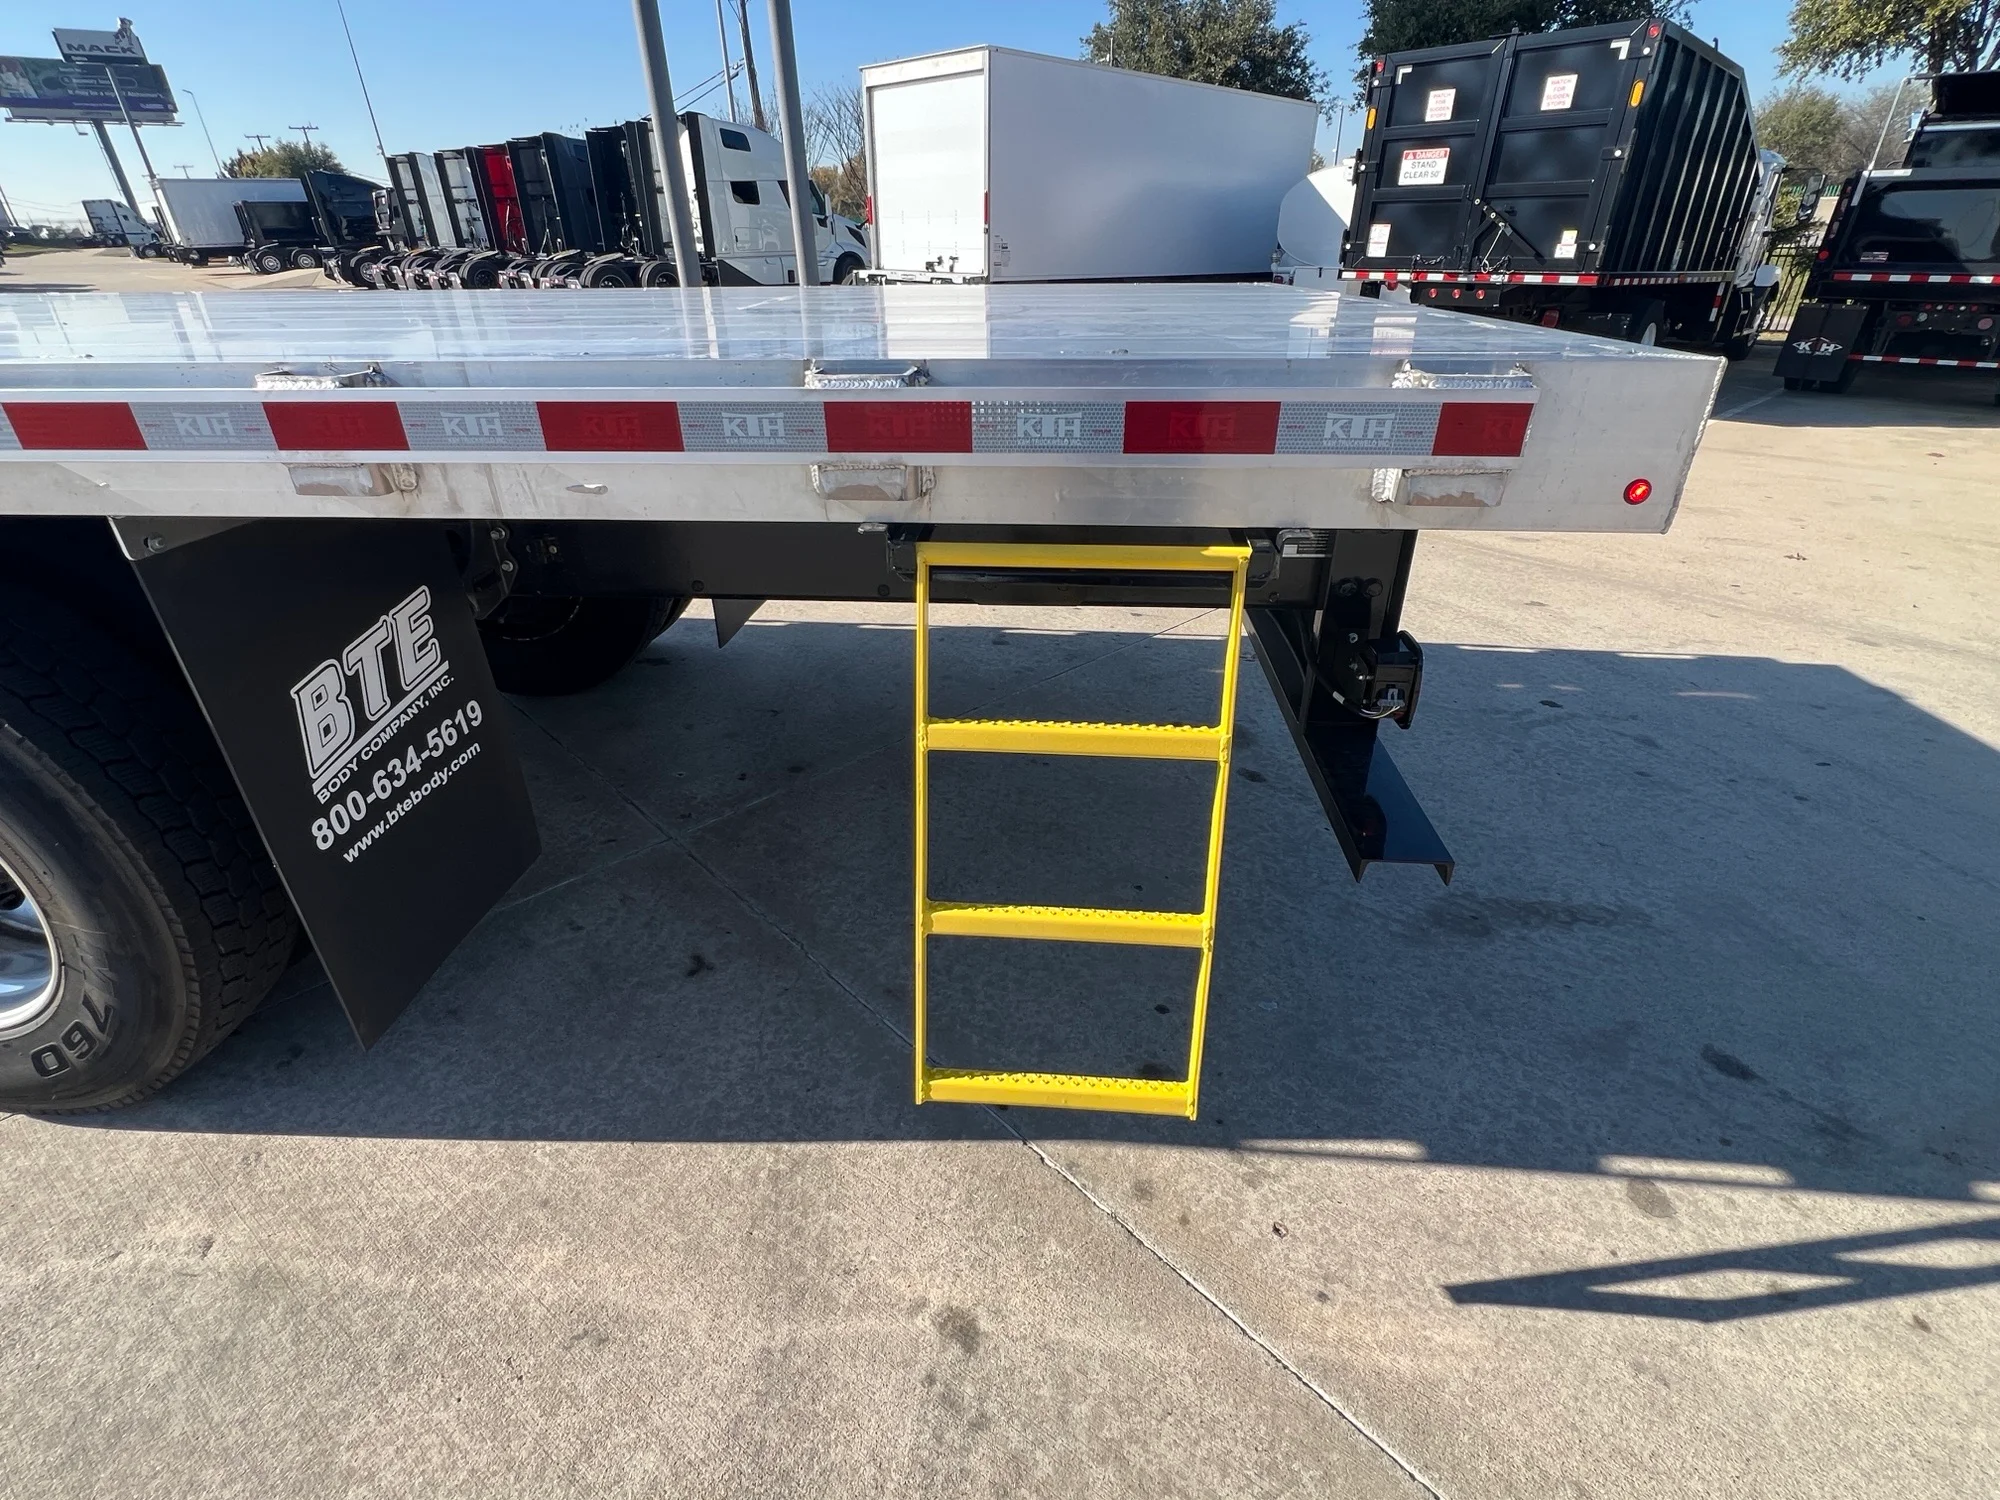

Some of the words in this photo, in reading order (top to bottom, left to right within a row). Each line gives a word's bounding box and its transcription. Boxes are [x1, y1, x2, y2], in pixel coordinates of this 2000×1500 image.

[66, 43, 138, 55] MACK
[1411, 161, 1437, 169] STAND
[1416, 150, 1446, 159] DANGER
[1403, 171, 1430, 179] CLEAR
[171, 412, 237, 436] KTH
[440, 412, 504, 436] KTH
[722, 412, 786, 437] KTH
[1017, 412, 1082, 438] KTH
[1324, 412, 1396, 438] KTH
[290, 585, 441, 779] BTE
[316, 760, 360, 804] BODY
[360, 699, 430, 762] COMPANY,
[428, 674, 455, 699] INC.
[311, 699, 483, 850] 800-634-5619
[343, 742, 481, 863] www.btebody.com
[30, 990, 117, 1079] 760
